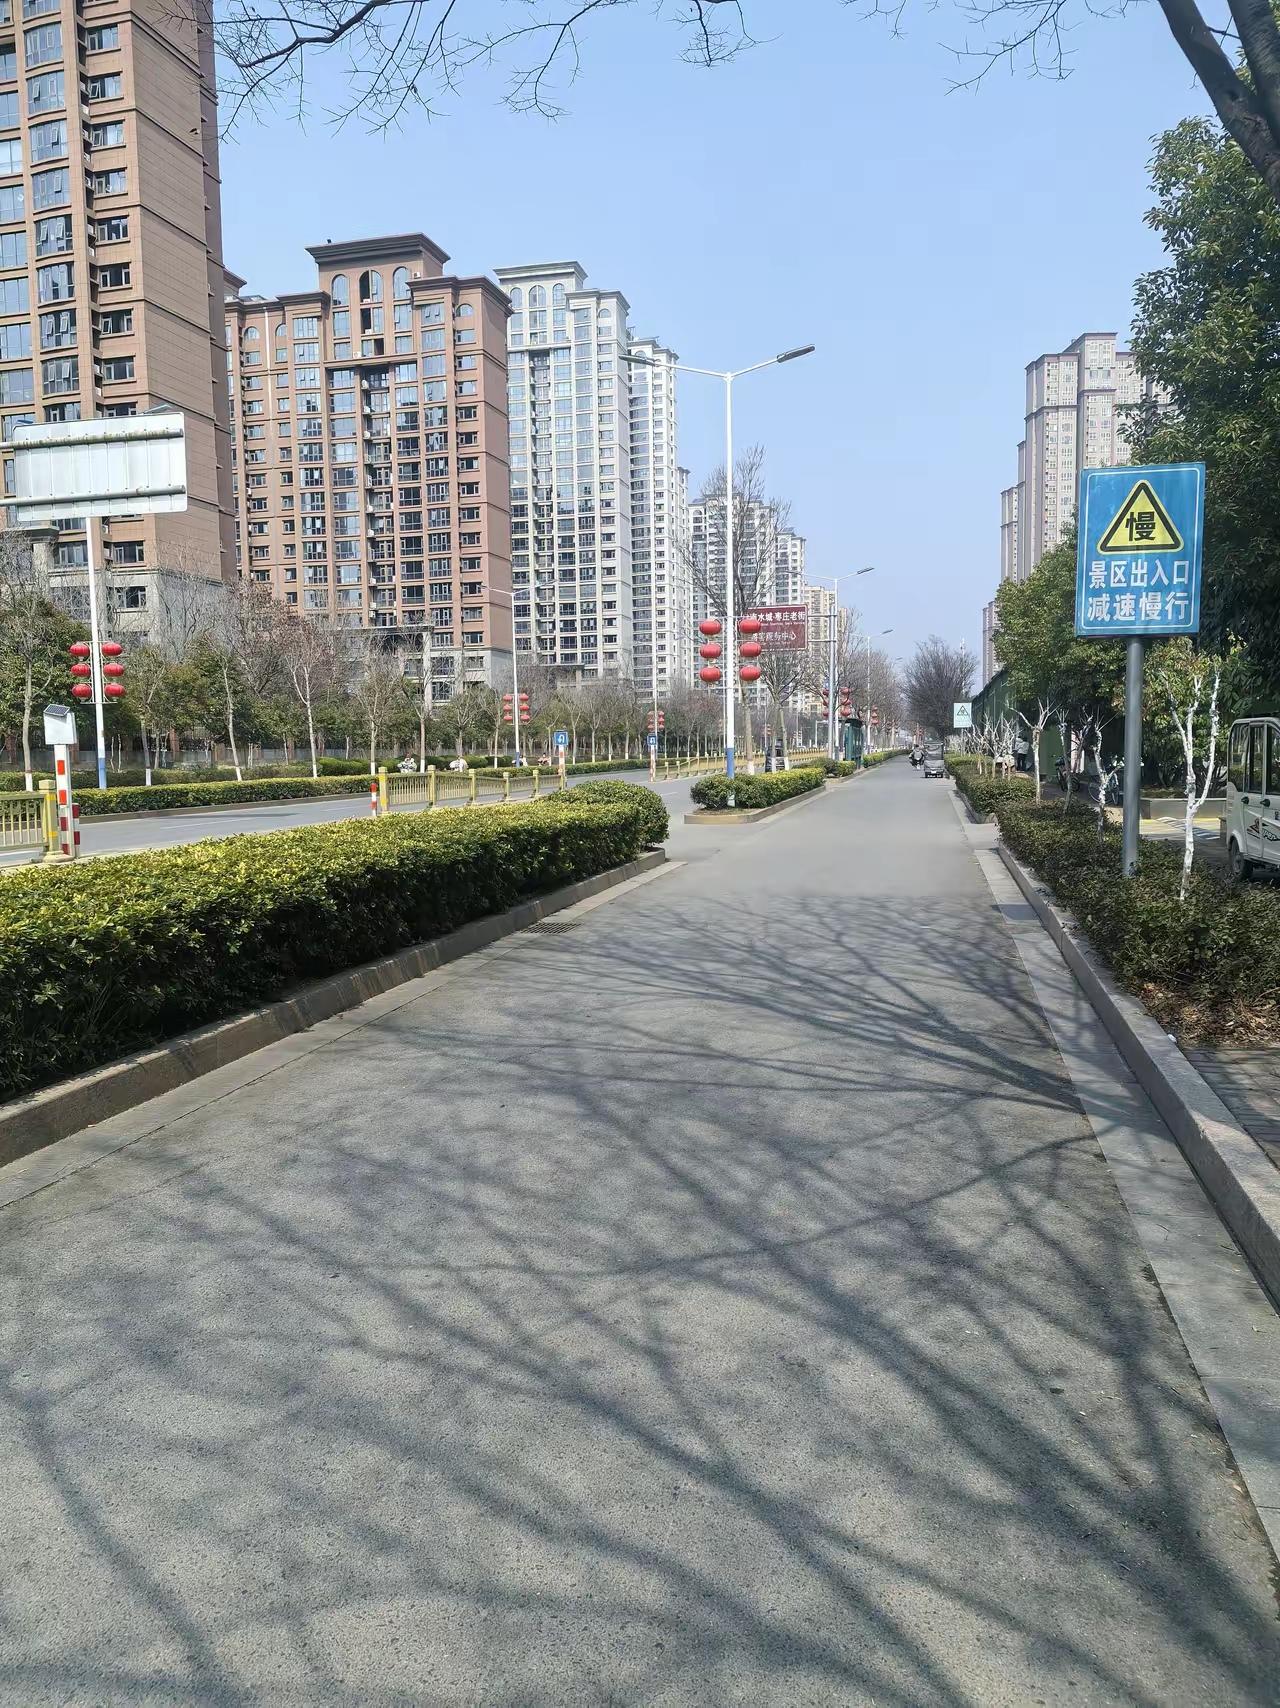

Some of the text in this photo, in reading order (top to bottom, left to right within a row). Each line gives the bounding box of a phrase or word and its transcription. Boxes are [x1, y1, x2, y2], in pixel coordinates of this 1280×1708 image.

[1125, 511, 1156, 541] 慢
[1089, 559, 1189, 589] 景区出入口
[1087, 591, 1189, 622] 减速慢行
